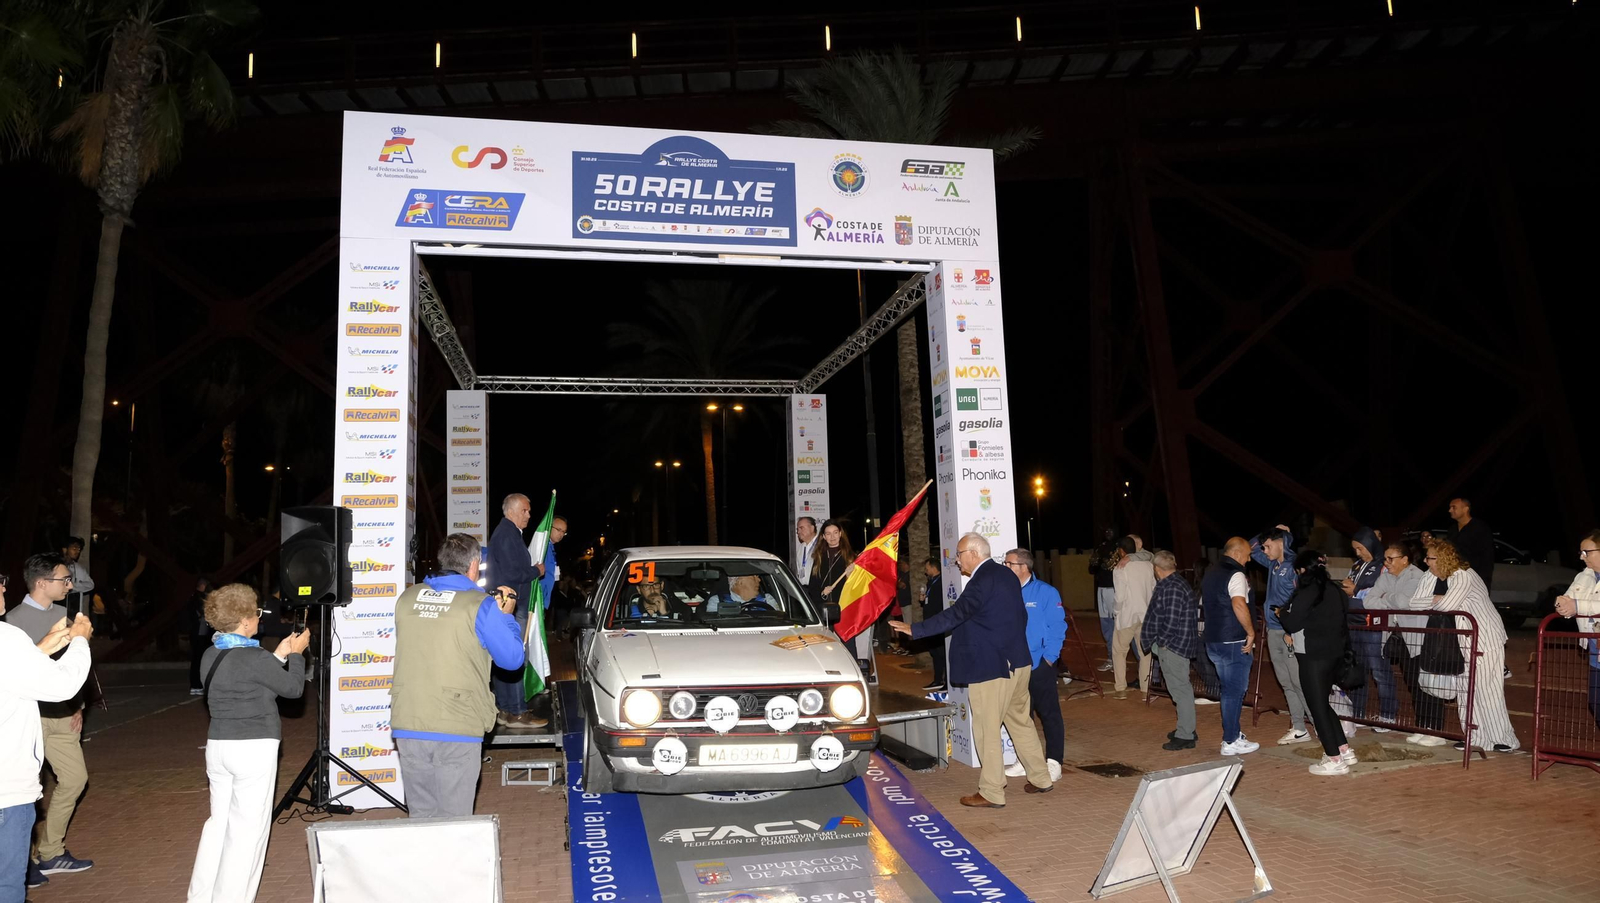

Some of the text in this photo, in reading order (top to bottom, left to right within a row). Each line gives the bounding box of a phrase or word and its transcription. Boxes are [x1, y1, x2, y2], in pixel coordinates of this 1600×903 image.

[594, 173, 776, 203] 50 RALLYE
[444, 195, 510, 209] CERA
[594, 199, 774, 218] COSTA DE ALMERÍA
[457, 215, 498, 226] Recalvi
[836, 221, 883, 231] COSTA DE
[827, 230, 885, 244] ALMERÍA
[918, 225, 981, 237] DIPUTACIÓN
[918, 236, 979, 247] DE ALMERÍA
[350, 301, 400, 313] Rallycar
[356, 325, 391, 335] Recalvi
[955, 365, 1001, 379] MOYA
[348, 386, 399, 398] Rallycar
[355, 411, 389, 420] Recalvi
[959, 417, 1003, 432] gasolia
[345, 472, 397, 484] Rallycar
[962, 468, 1006, 480] Phonika
[798, 487, 826, 496] gasolia
[352, 497, 387, 506] Recalvi
[350, 560, 395, 572] allycar
[628, 562, 656, 584] 51
[413, 604, 451, 613] FOTO/TV
[418, 611, 439, 619] 2025
[343, 652, 395, 664] Rallycar
[349, 678, 386, 688] Recalvi
[341, 746, 394, 757] Rallycar
[683, 830, 836, 848] FEDERACIÓN DE AUTOMOVILISMO
[760, 831, 874, 846] COMUNITAT VALENCIANA
[742, 854, 859, 872] DIPUTACIÓN
[907, 814, 1006, 900] www.garcia
[748, 862, 864, 880] DE ALMERÍA
[852, 890, 877, 899] DE
